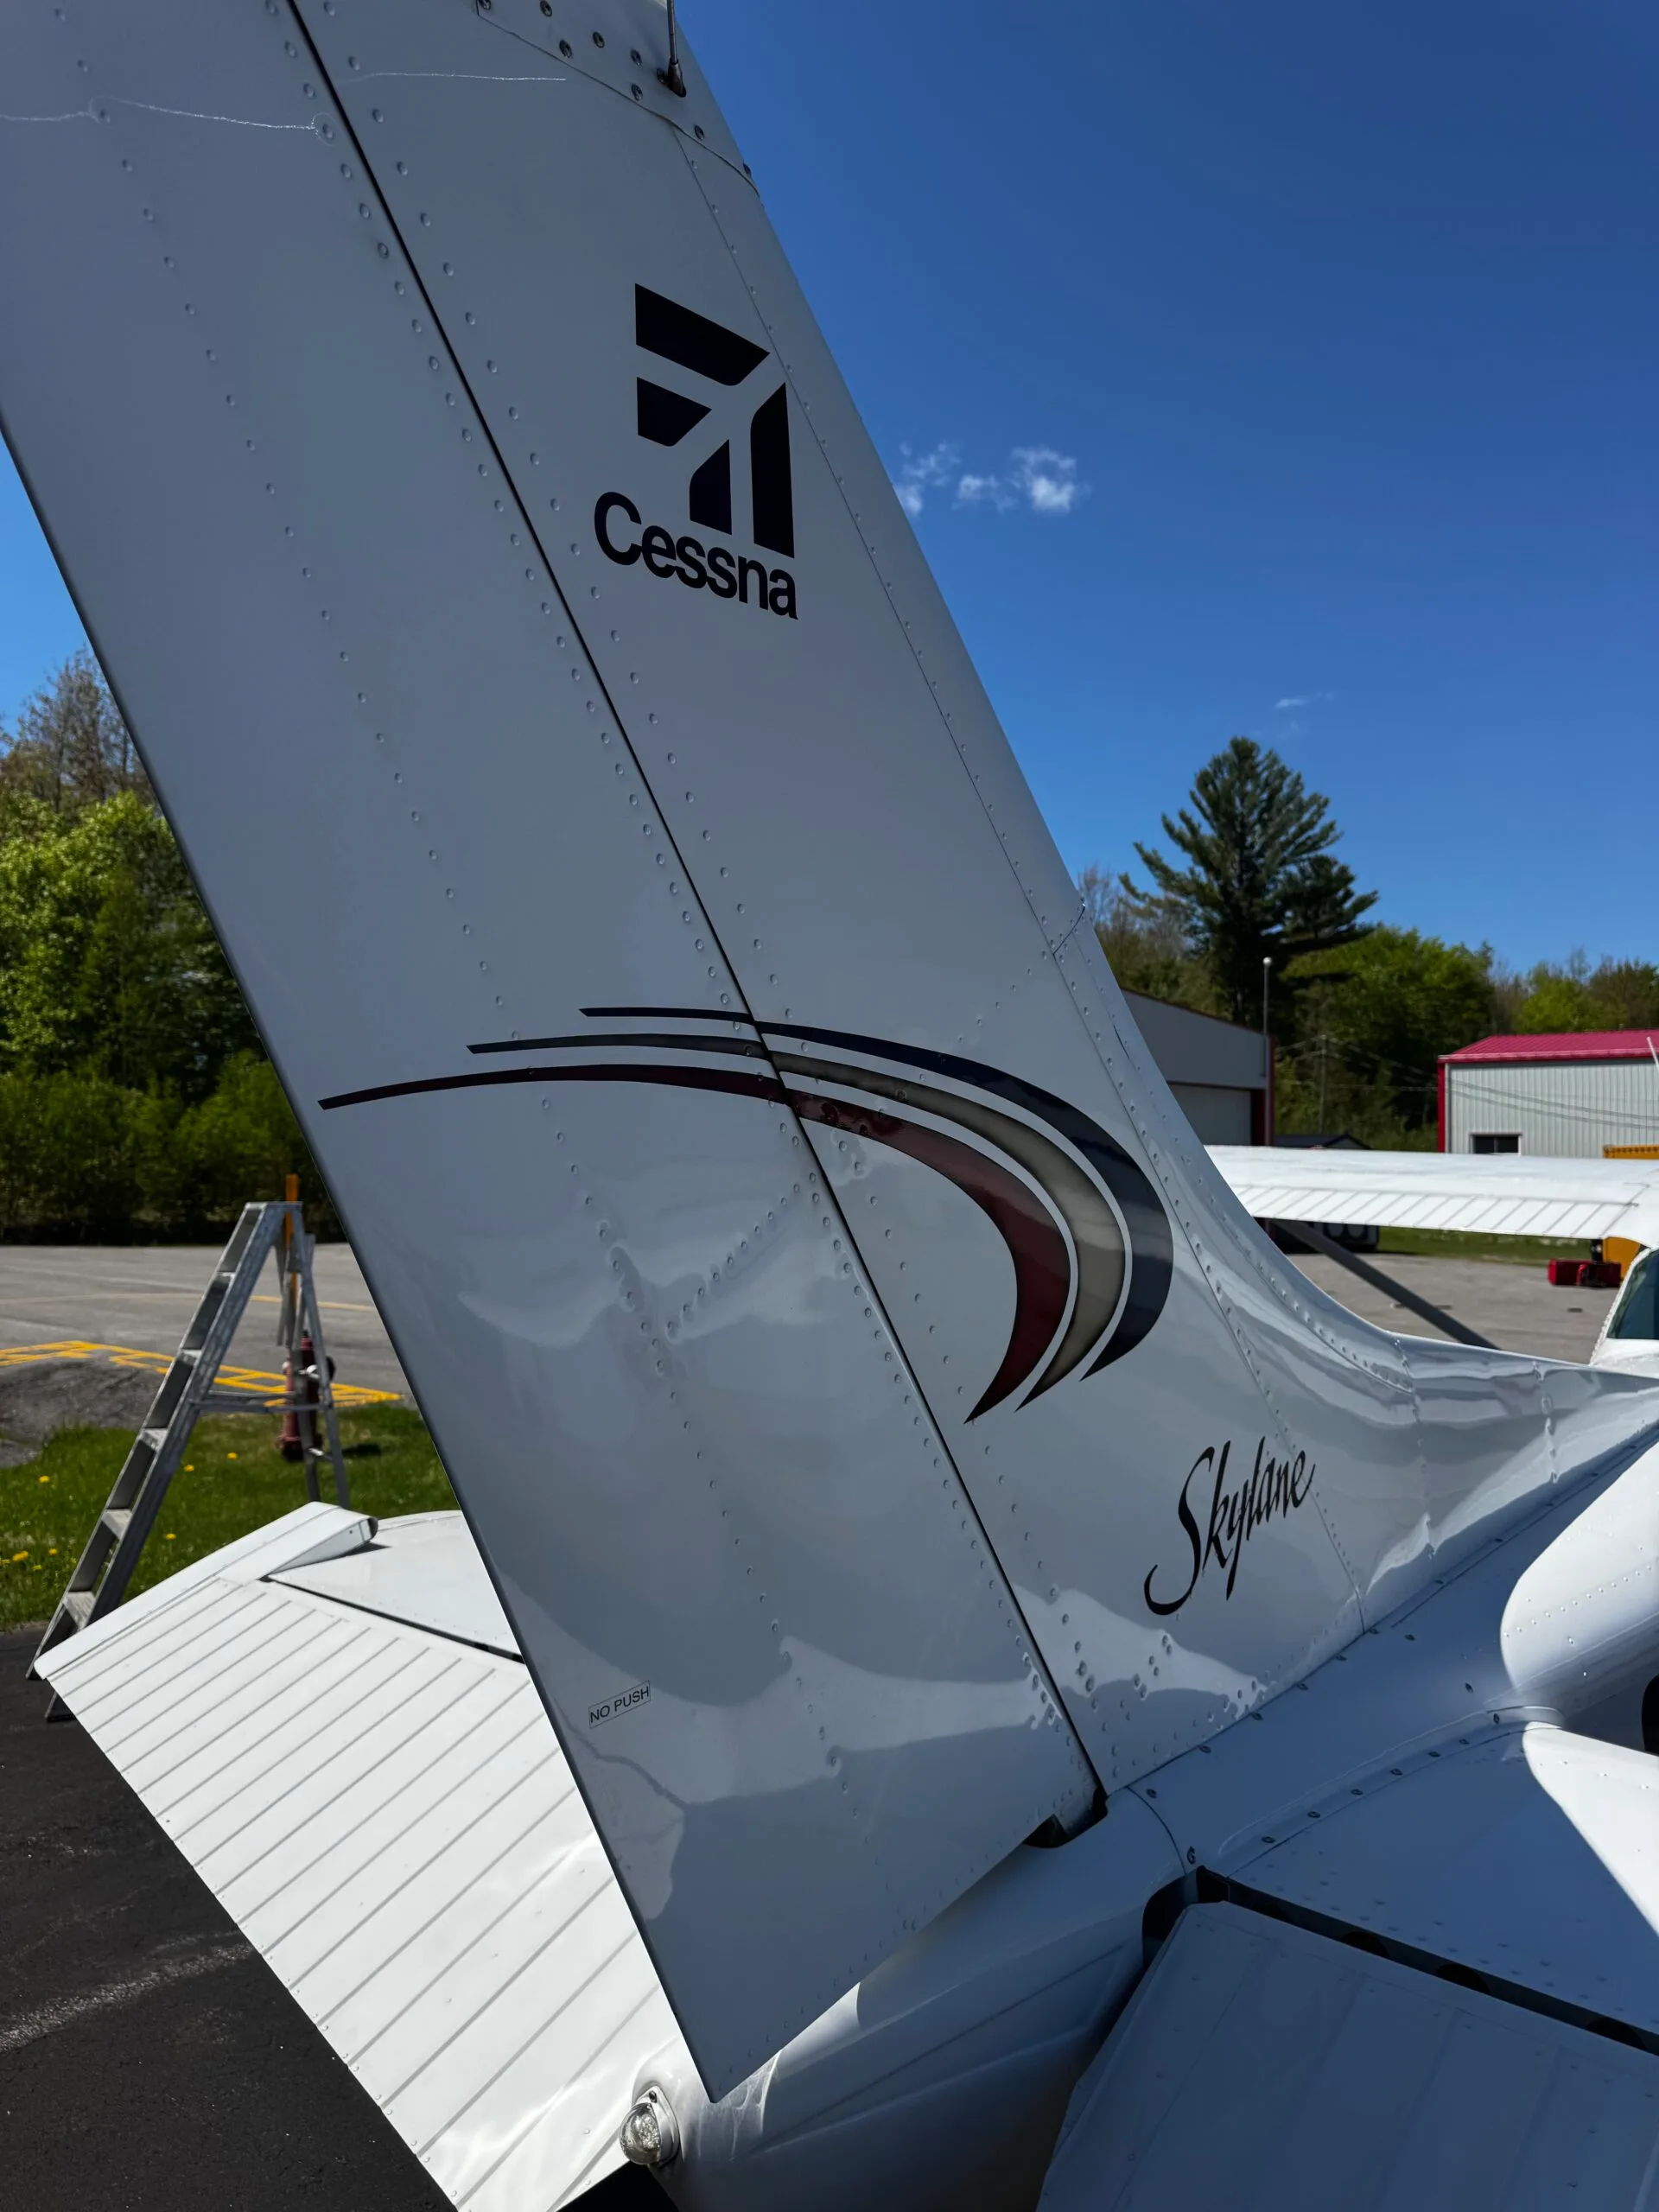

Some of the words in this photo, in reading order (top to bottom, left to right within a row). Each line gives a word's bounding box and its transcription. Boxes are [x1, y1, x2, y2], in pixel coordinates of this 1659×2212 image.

[594, 491, 798, 620] Cessna
[1143, 1435, 1316, 1615] Skylane
[590, 1705, 610, 1723] NO
[614, 1686, 649, 1712] PUSH
